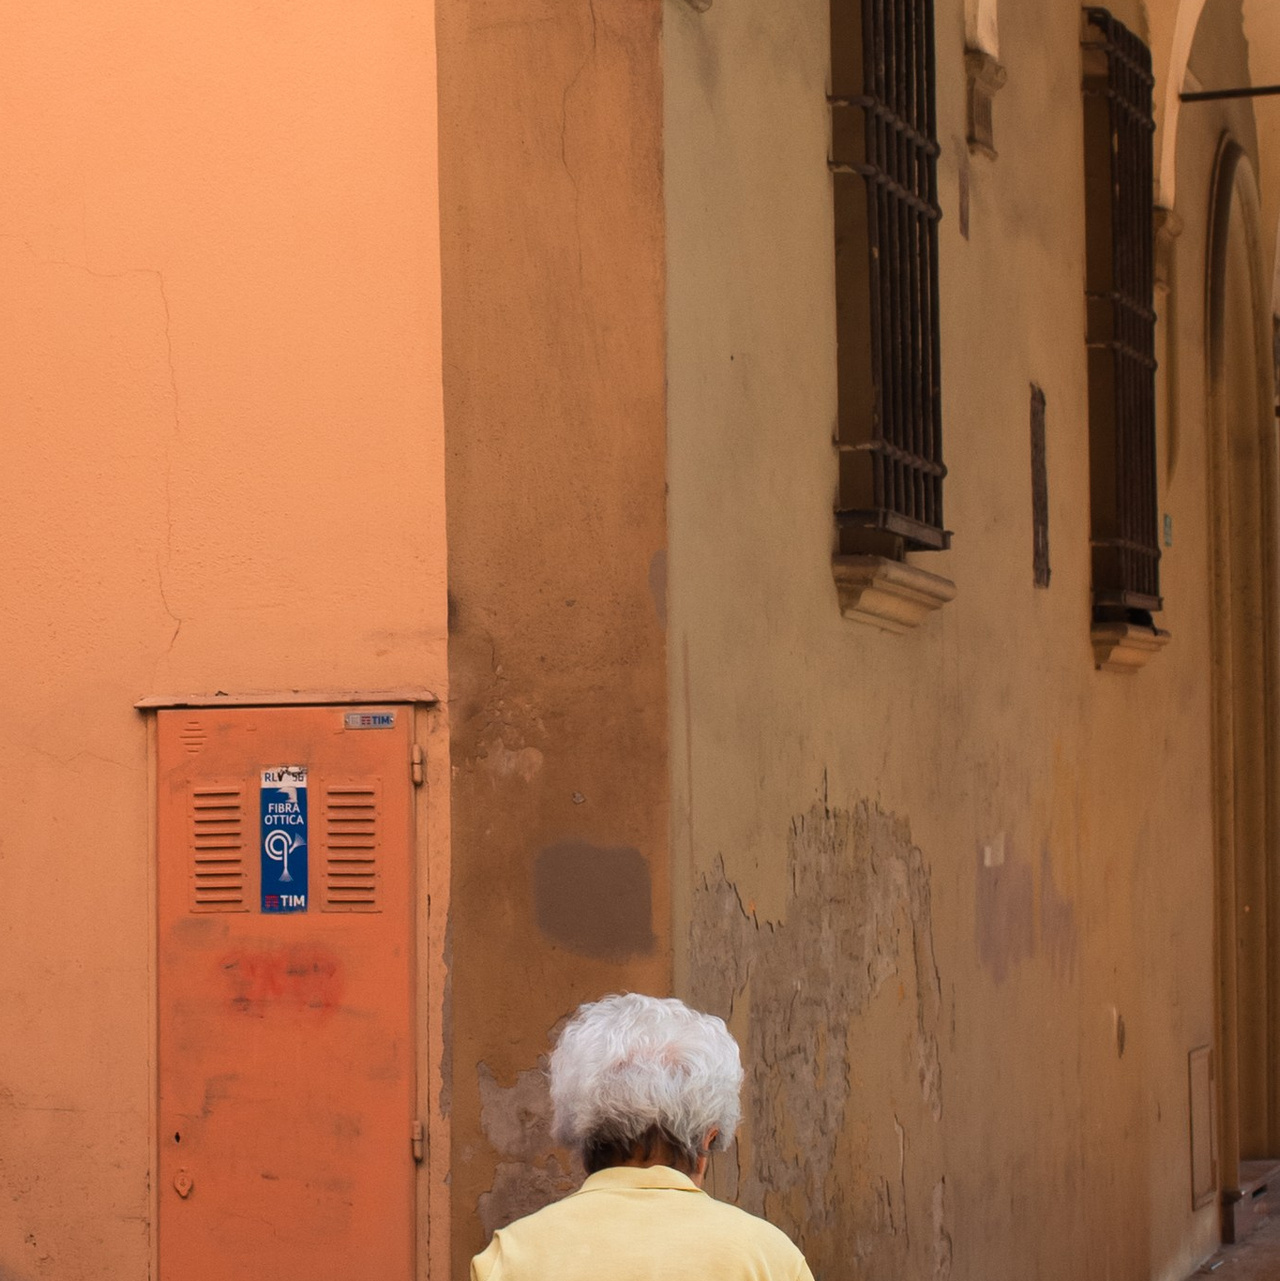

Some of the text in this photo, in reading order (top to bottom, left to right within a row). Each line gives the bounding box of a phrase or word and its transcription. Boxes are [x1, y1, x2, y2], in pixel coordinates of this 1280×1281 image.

[372, 715, 390, 725] TIM
[268, 803, 300, 813] FIBRA
[264, 814, 304, 825] OTTICA
[280, 895, 305, 907] TIM
